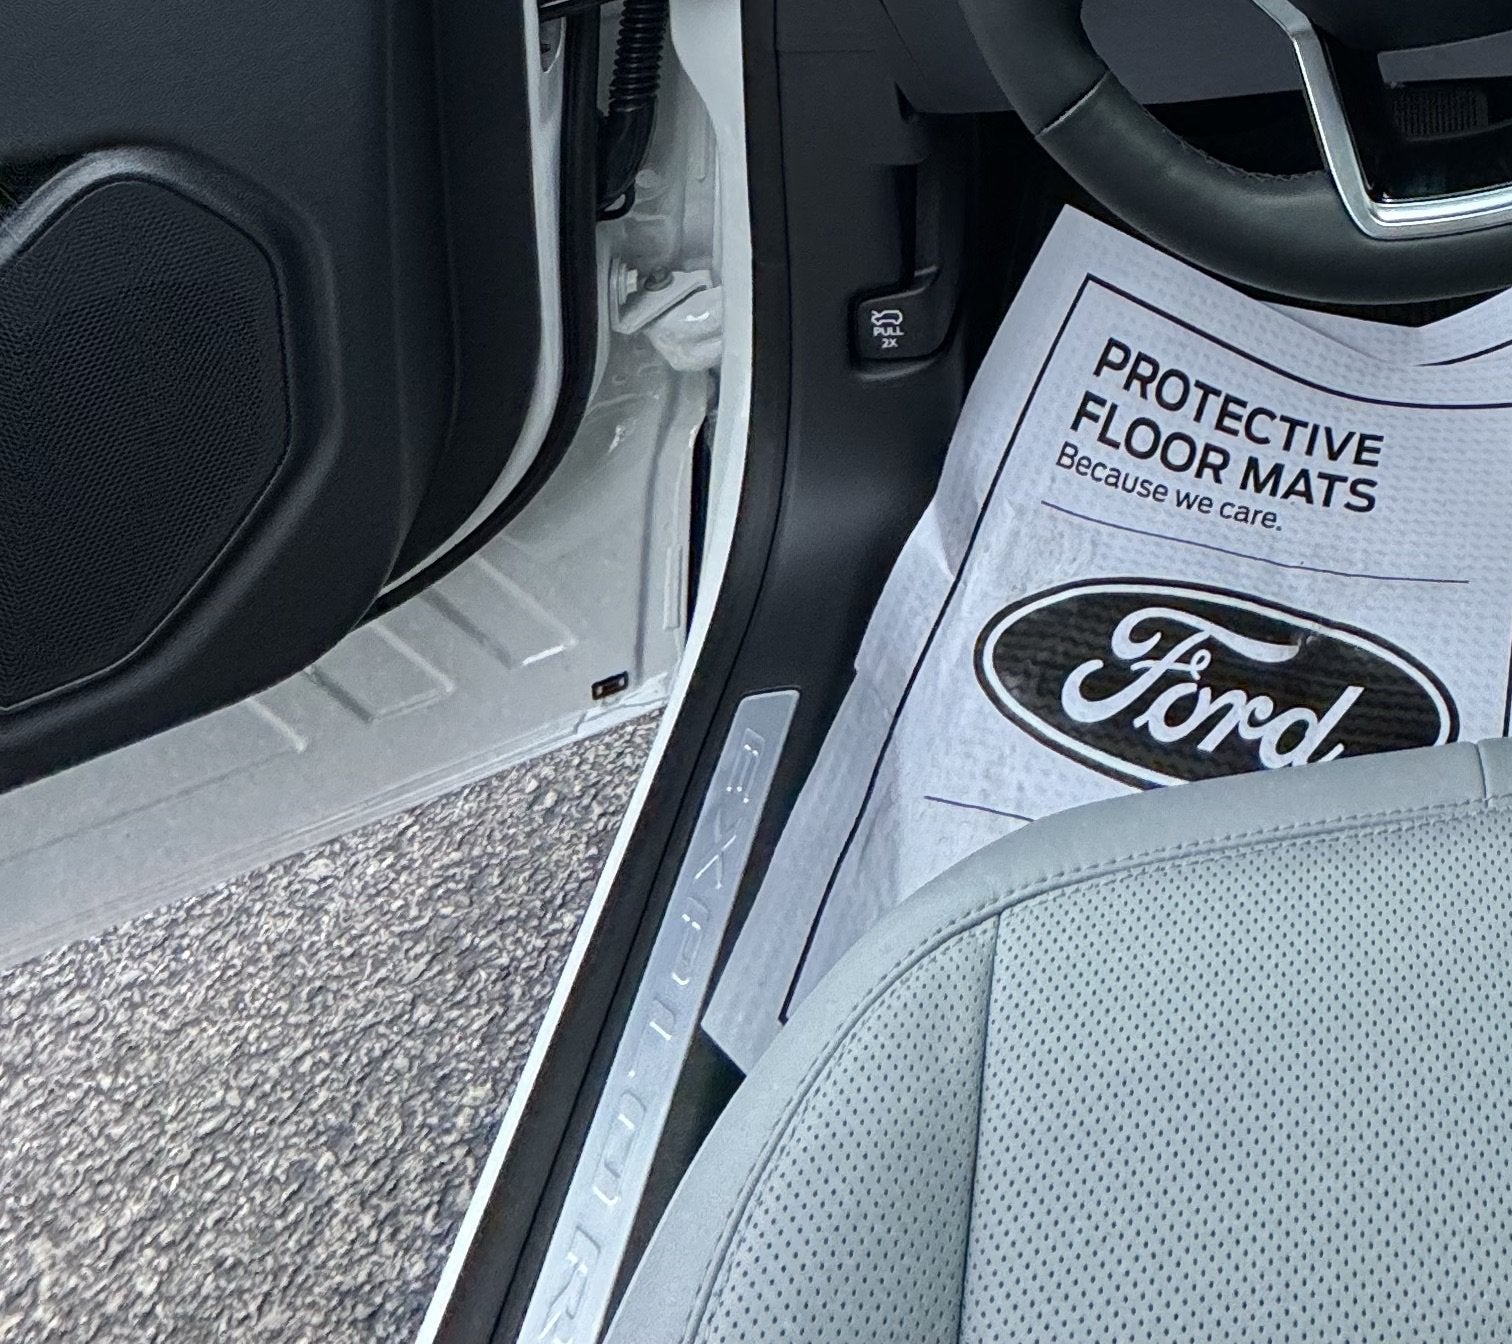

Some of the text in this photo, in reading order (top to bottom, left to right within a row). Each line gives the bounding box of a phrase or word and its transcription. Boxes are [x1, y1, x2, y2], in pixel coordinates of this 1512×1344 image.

[873, 326, 905, 337] PULL
[881, 337, 898, 349] 2X
[1069, 389, 1379, 513] FLOOR MATS
[1093, 336, 1385, 467] PROTECTIVE
[1055, 440, 1283, 532] Because we care.
[1061, 606, 1365, 769] Ford
